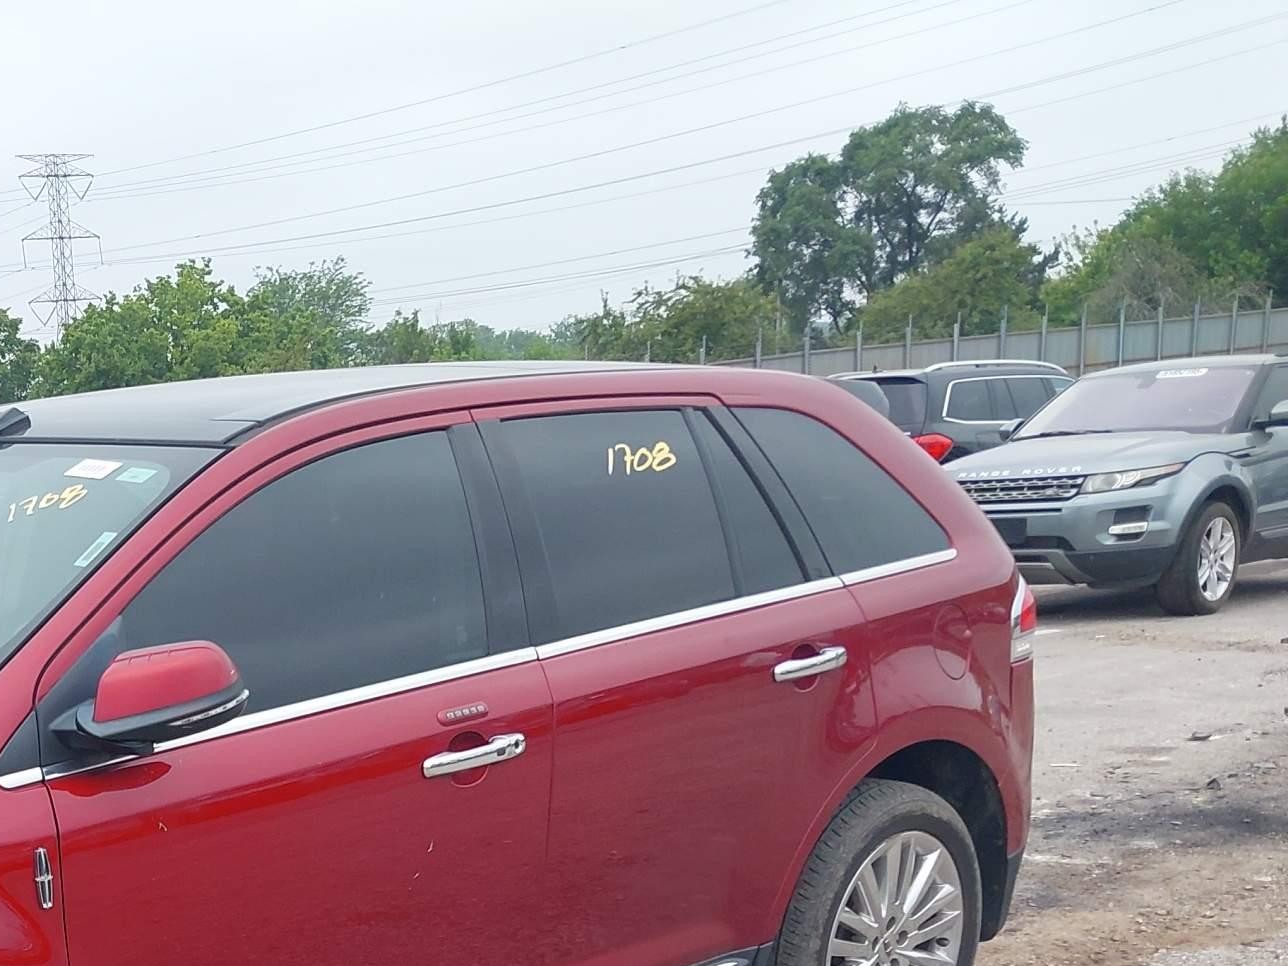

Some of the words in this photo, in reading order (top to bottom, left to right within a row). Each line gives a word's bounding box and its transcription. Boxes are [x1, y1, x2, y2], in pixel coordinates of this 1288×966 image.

[607, 441, 677, 476] 1708
[957, 469, 1011, 479] RANGE
[1021, 465, 1083, 476] ROVER
[7, 483, 89, 523] 1708
